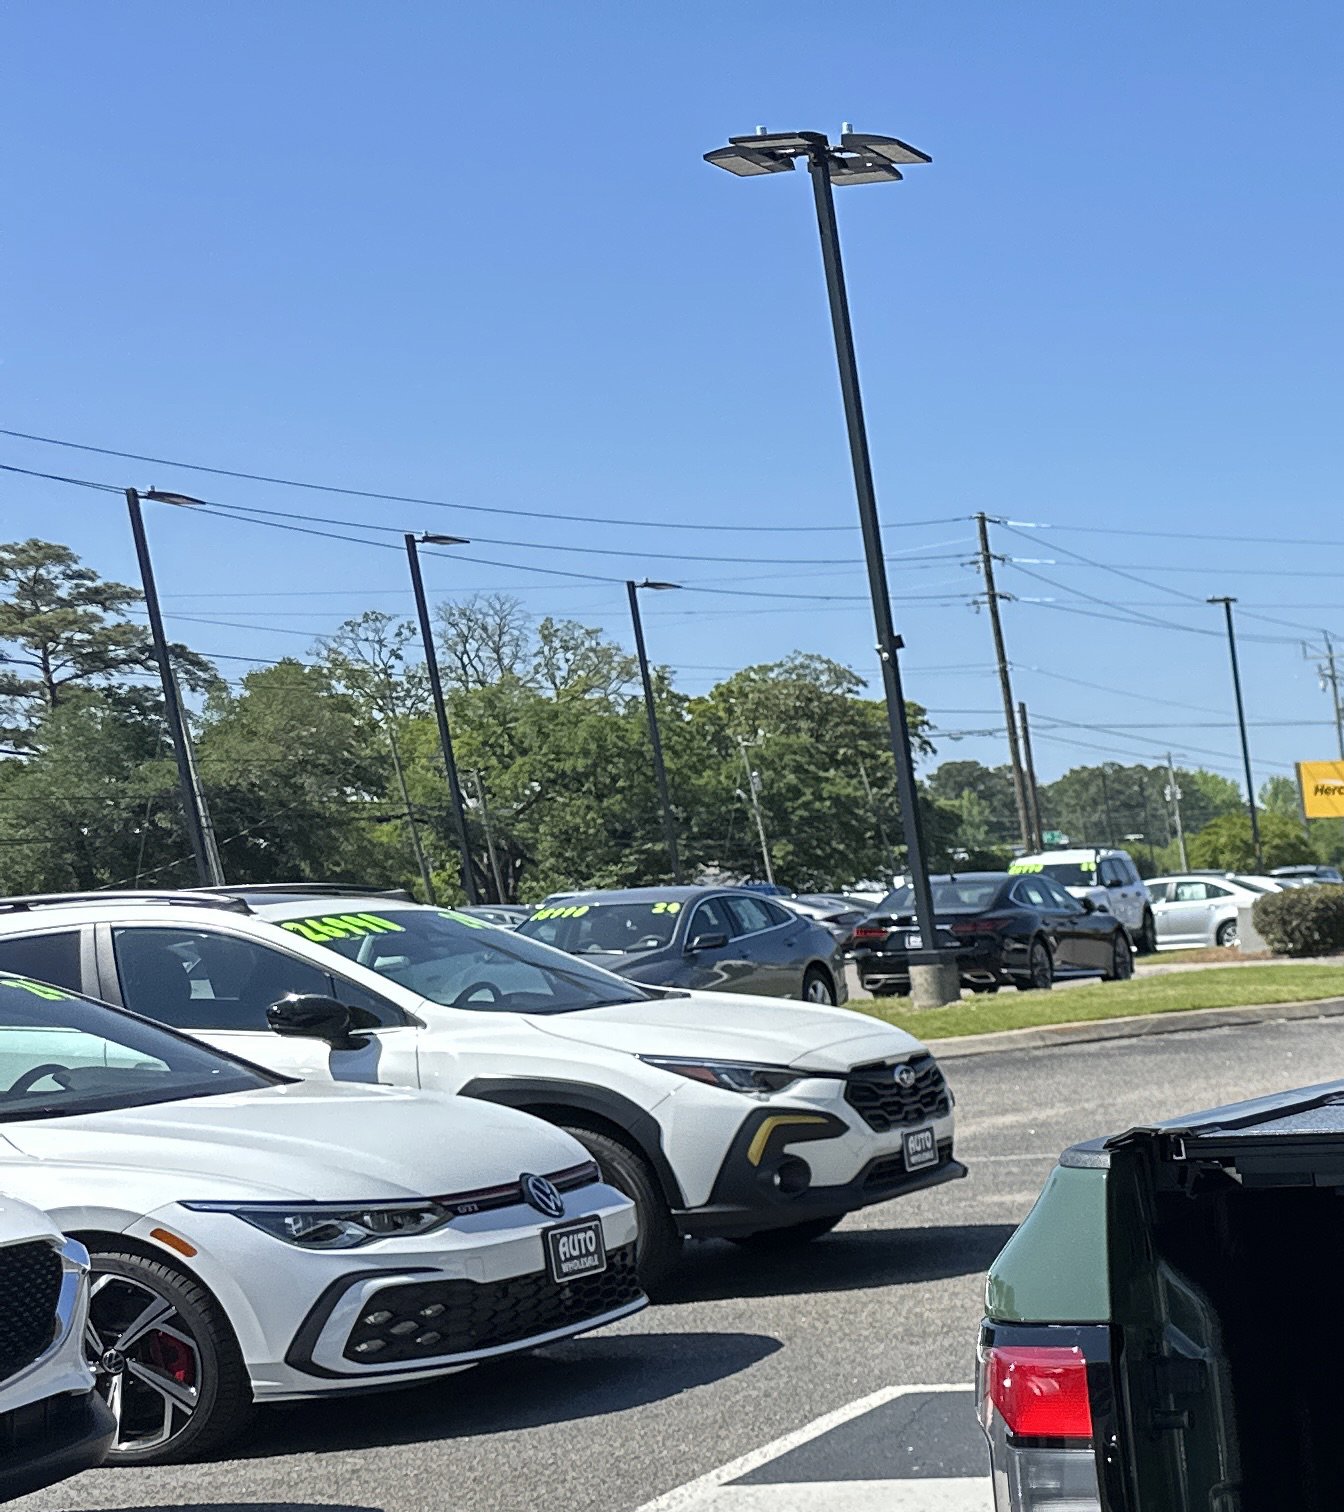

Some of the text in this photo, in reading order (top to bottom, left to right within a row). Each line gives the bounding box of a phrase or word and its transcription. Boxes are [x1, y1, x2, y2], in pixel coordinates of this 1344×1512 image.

[280, 912, 406, 942] 26990
[908, 1131, 932, 1154] AUTO
[558, 1230, 596, 1262] AUTO
